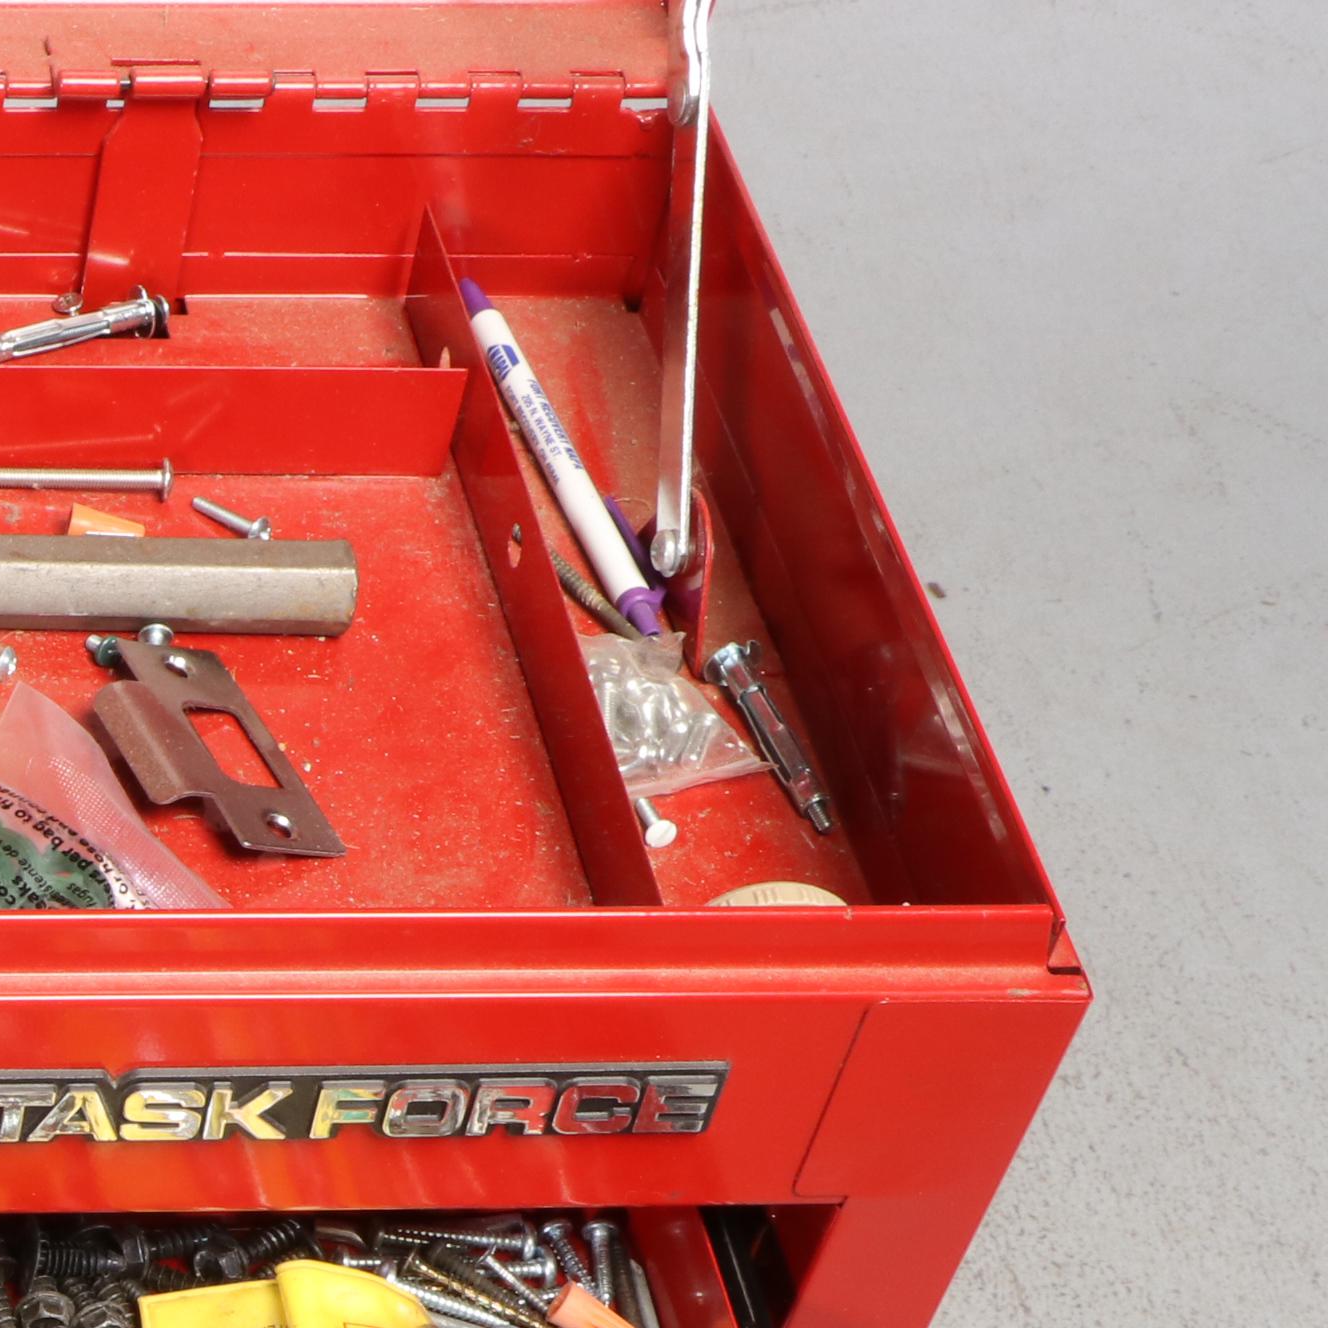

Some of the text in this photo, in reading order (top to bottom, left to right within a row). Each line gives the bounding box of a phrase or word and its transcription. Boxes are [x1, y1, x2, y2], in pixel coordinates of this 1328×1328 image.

[534, 416, 555, 445] WAYNE
[13, 806, 32, 825] to
[31, 817, 64, 849] bag
[61, 845, 92, 872] per
[10, 873, 49, 912] eaks
[309, 1076, 723, 1141] FORCE
